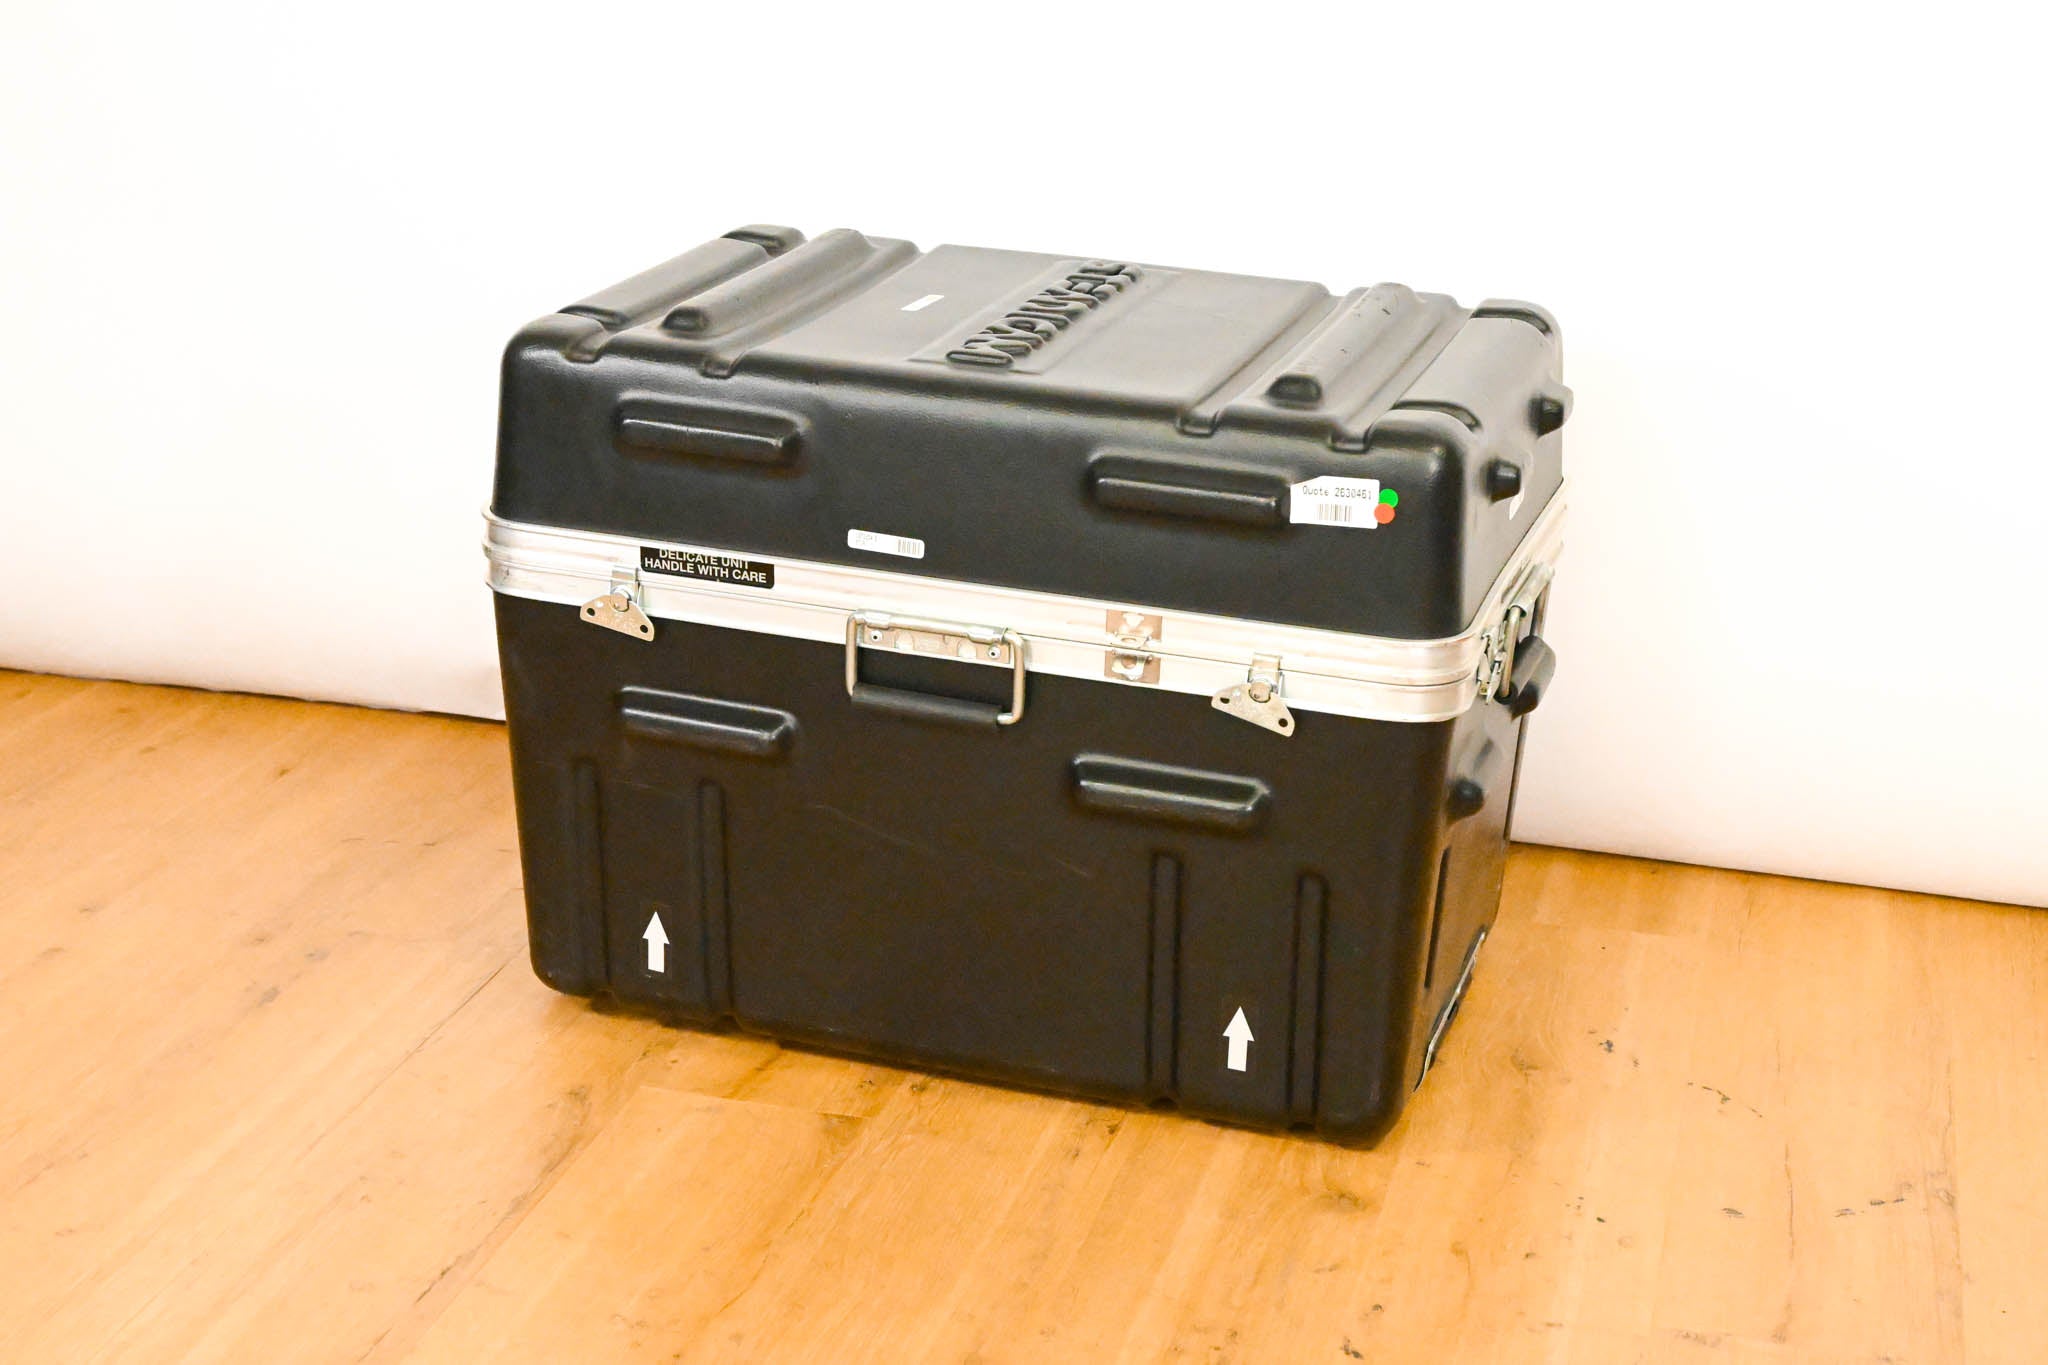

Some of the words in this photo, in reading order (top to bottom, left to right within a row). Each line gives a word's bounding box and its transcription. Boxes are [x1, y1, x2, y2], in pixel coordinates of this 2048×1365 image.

[1302, 485, 1329, 496] Quote
[644, 557, 695, 574] HANDLE
[697, 564, 729, 578] WITH
[732, 569, 767, 583] CARE
[658, 549, 718, 565] DELICATE
[721, 557, 749, 570] UNIT
